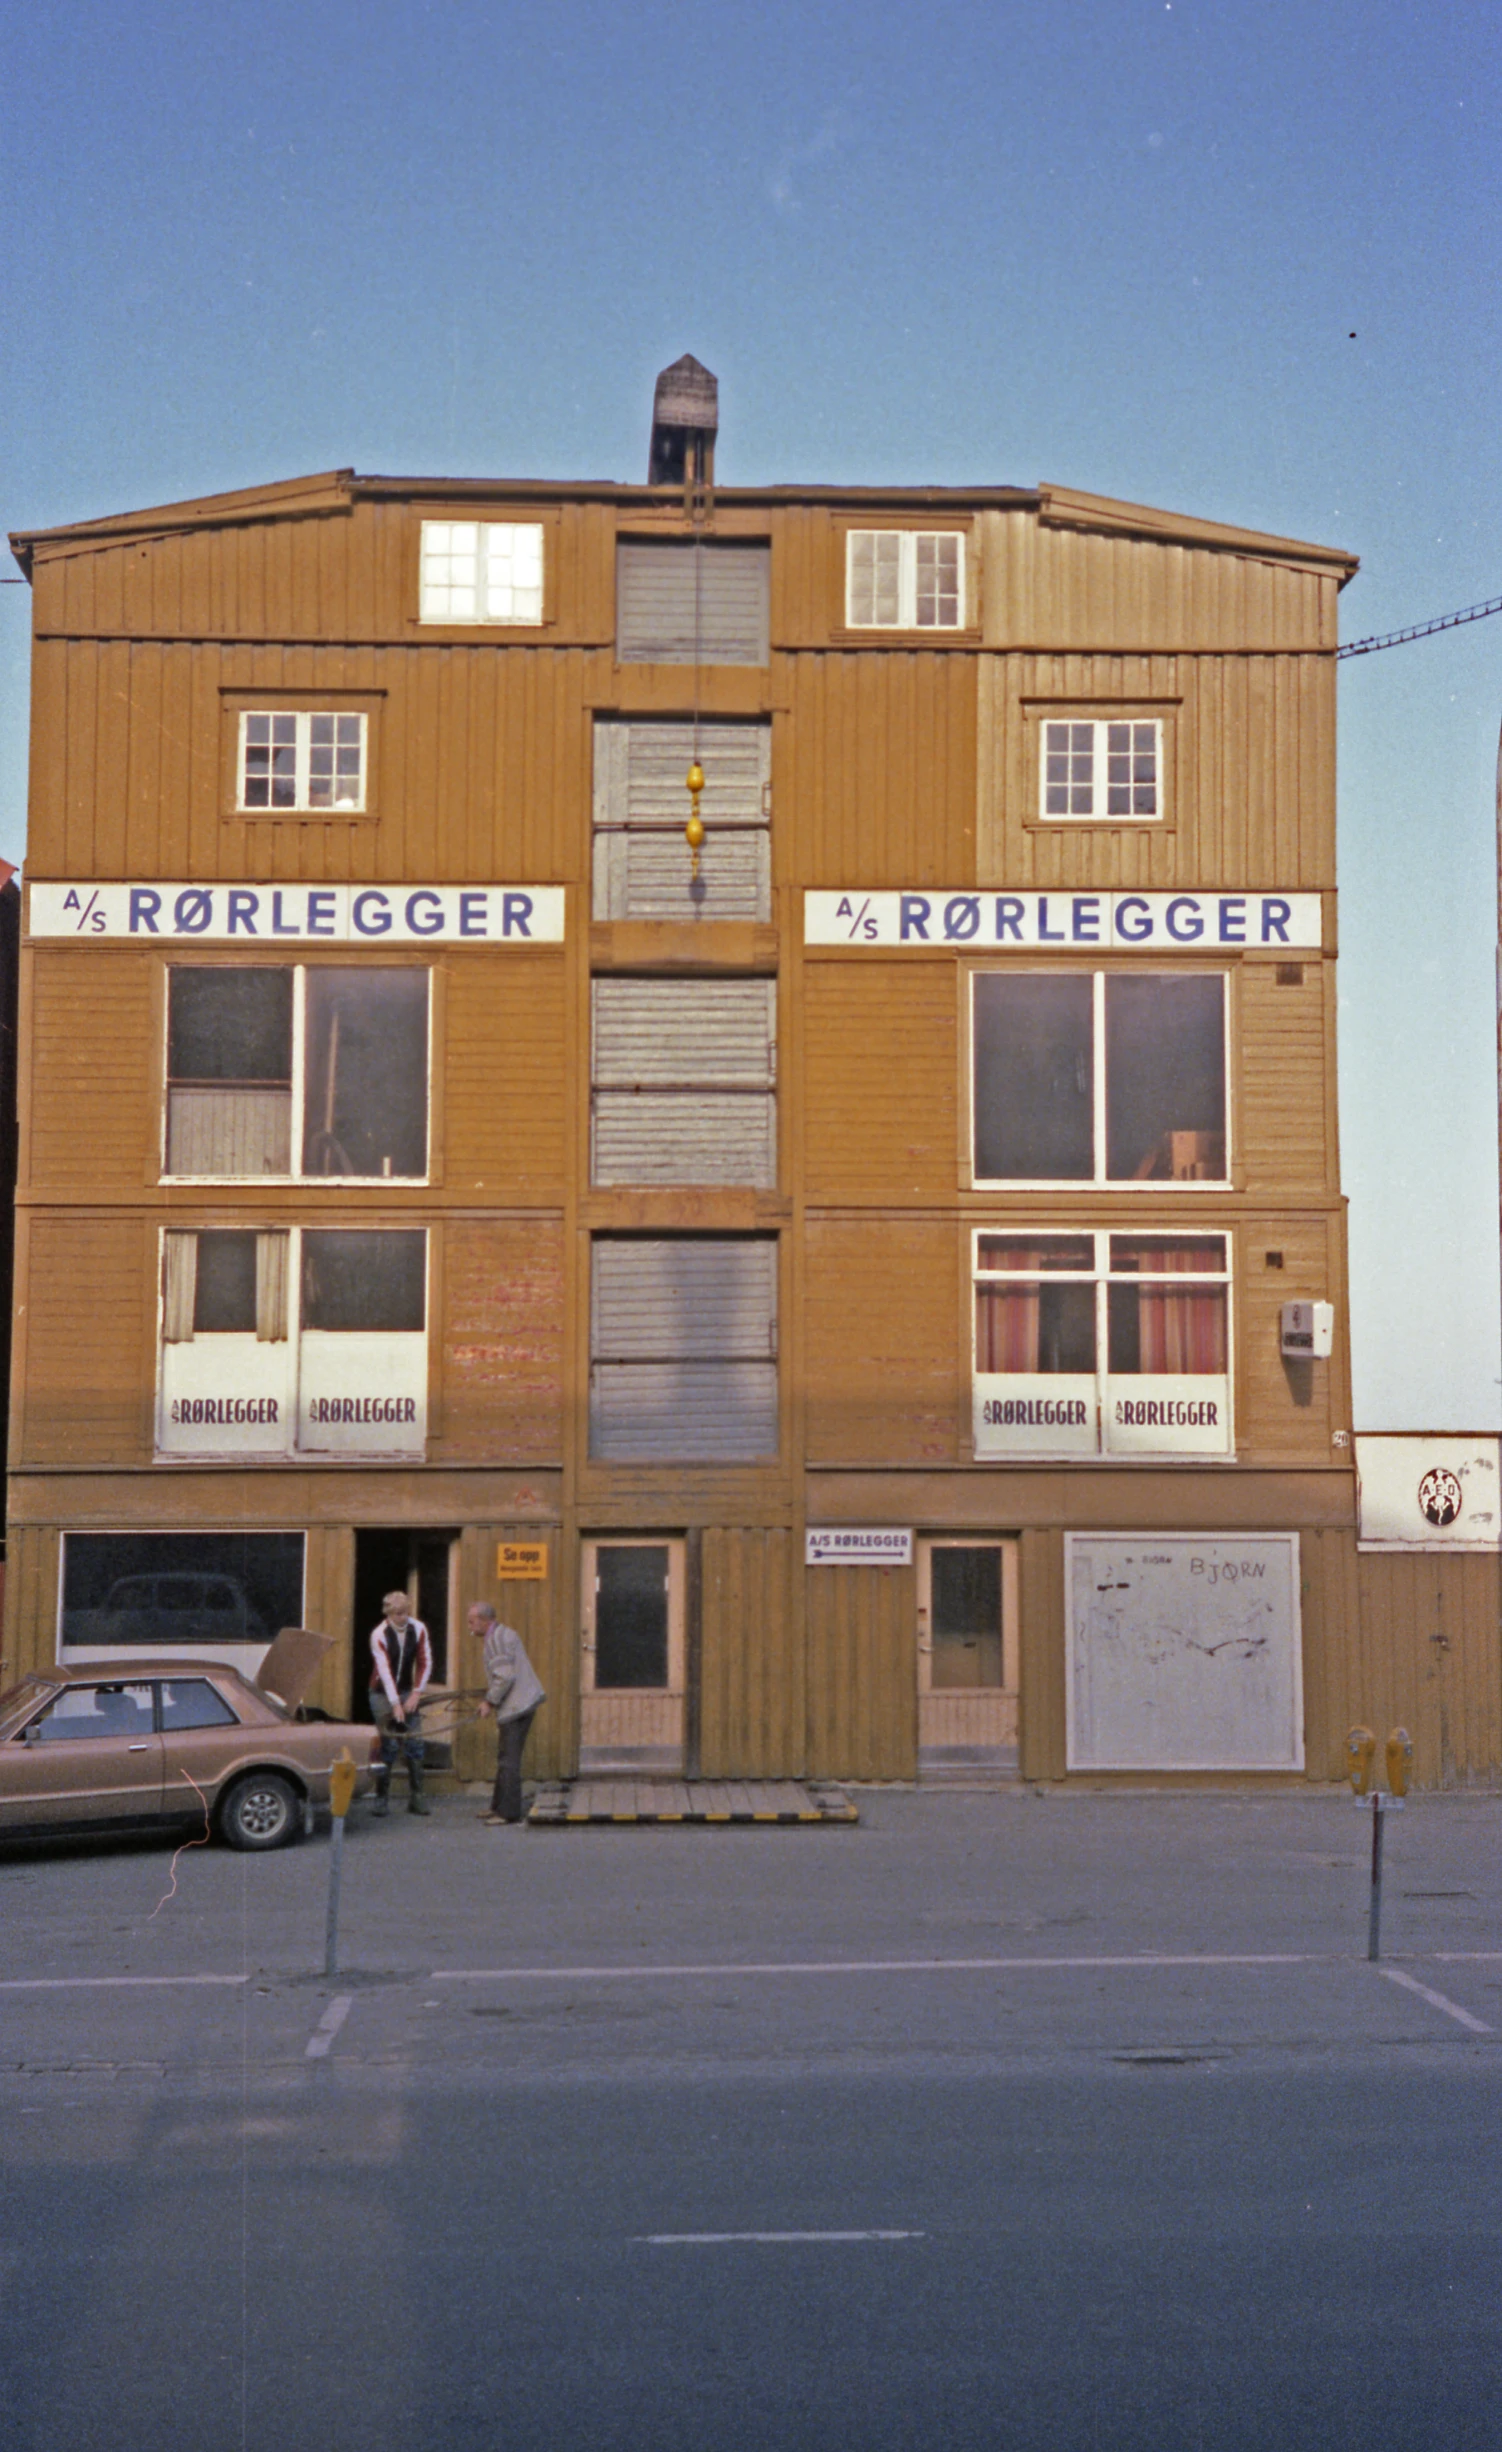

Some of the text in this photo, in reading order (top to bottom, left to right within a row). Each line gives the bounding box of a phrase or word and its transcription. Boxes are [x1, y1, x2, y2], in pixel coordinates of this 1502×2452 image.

[63, 888, 532, 936] A/S RØRLEGGER
[836, 896, 1290, 945] A/S RØRLEGGER
[180, 1398, 279, 1424] RØRLEGGER
[318, 1397, 416, 1423] RØRLEGGER
[992, 1399, 1087, 1425] RØRLEGGER
[1124, 1401, 1218, 1426] RØRLEGGER
[503, 1547, 517, 1561] Se
[809, 1534, 909, 1548] A/S RØRLEGGER
